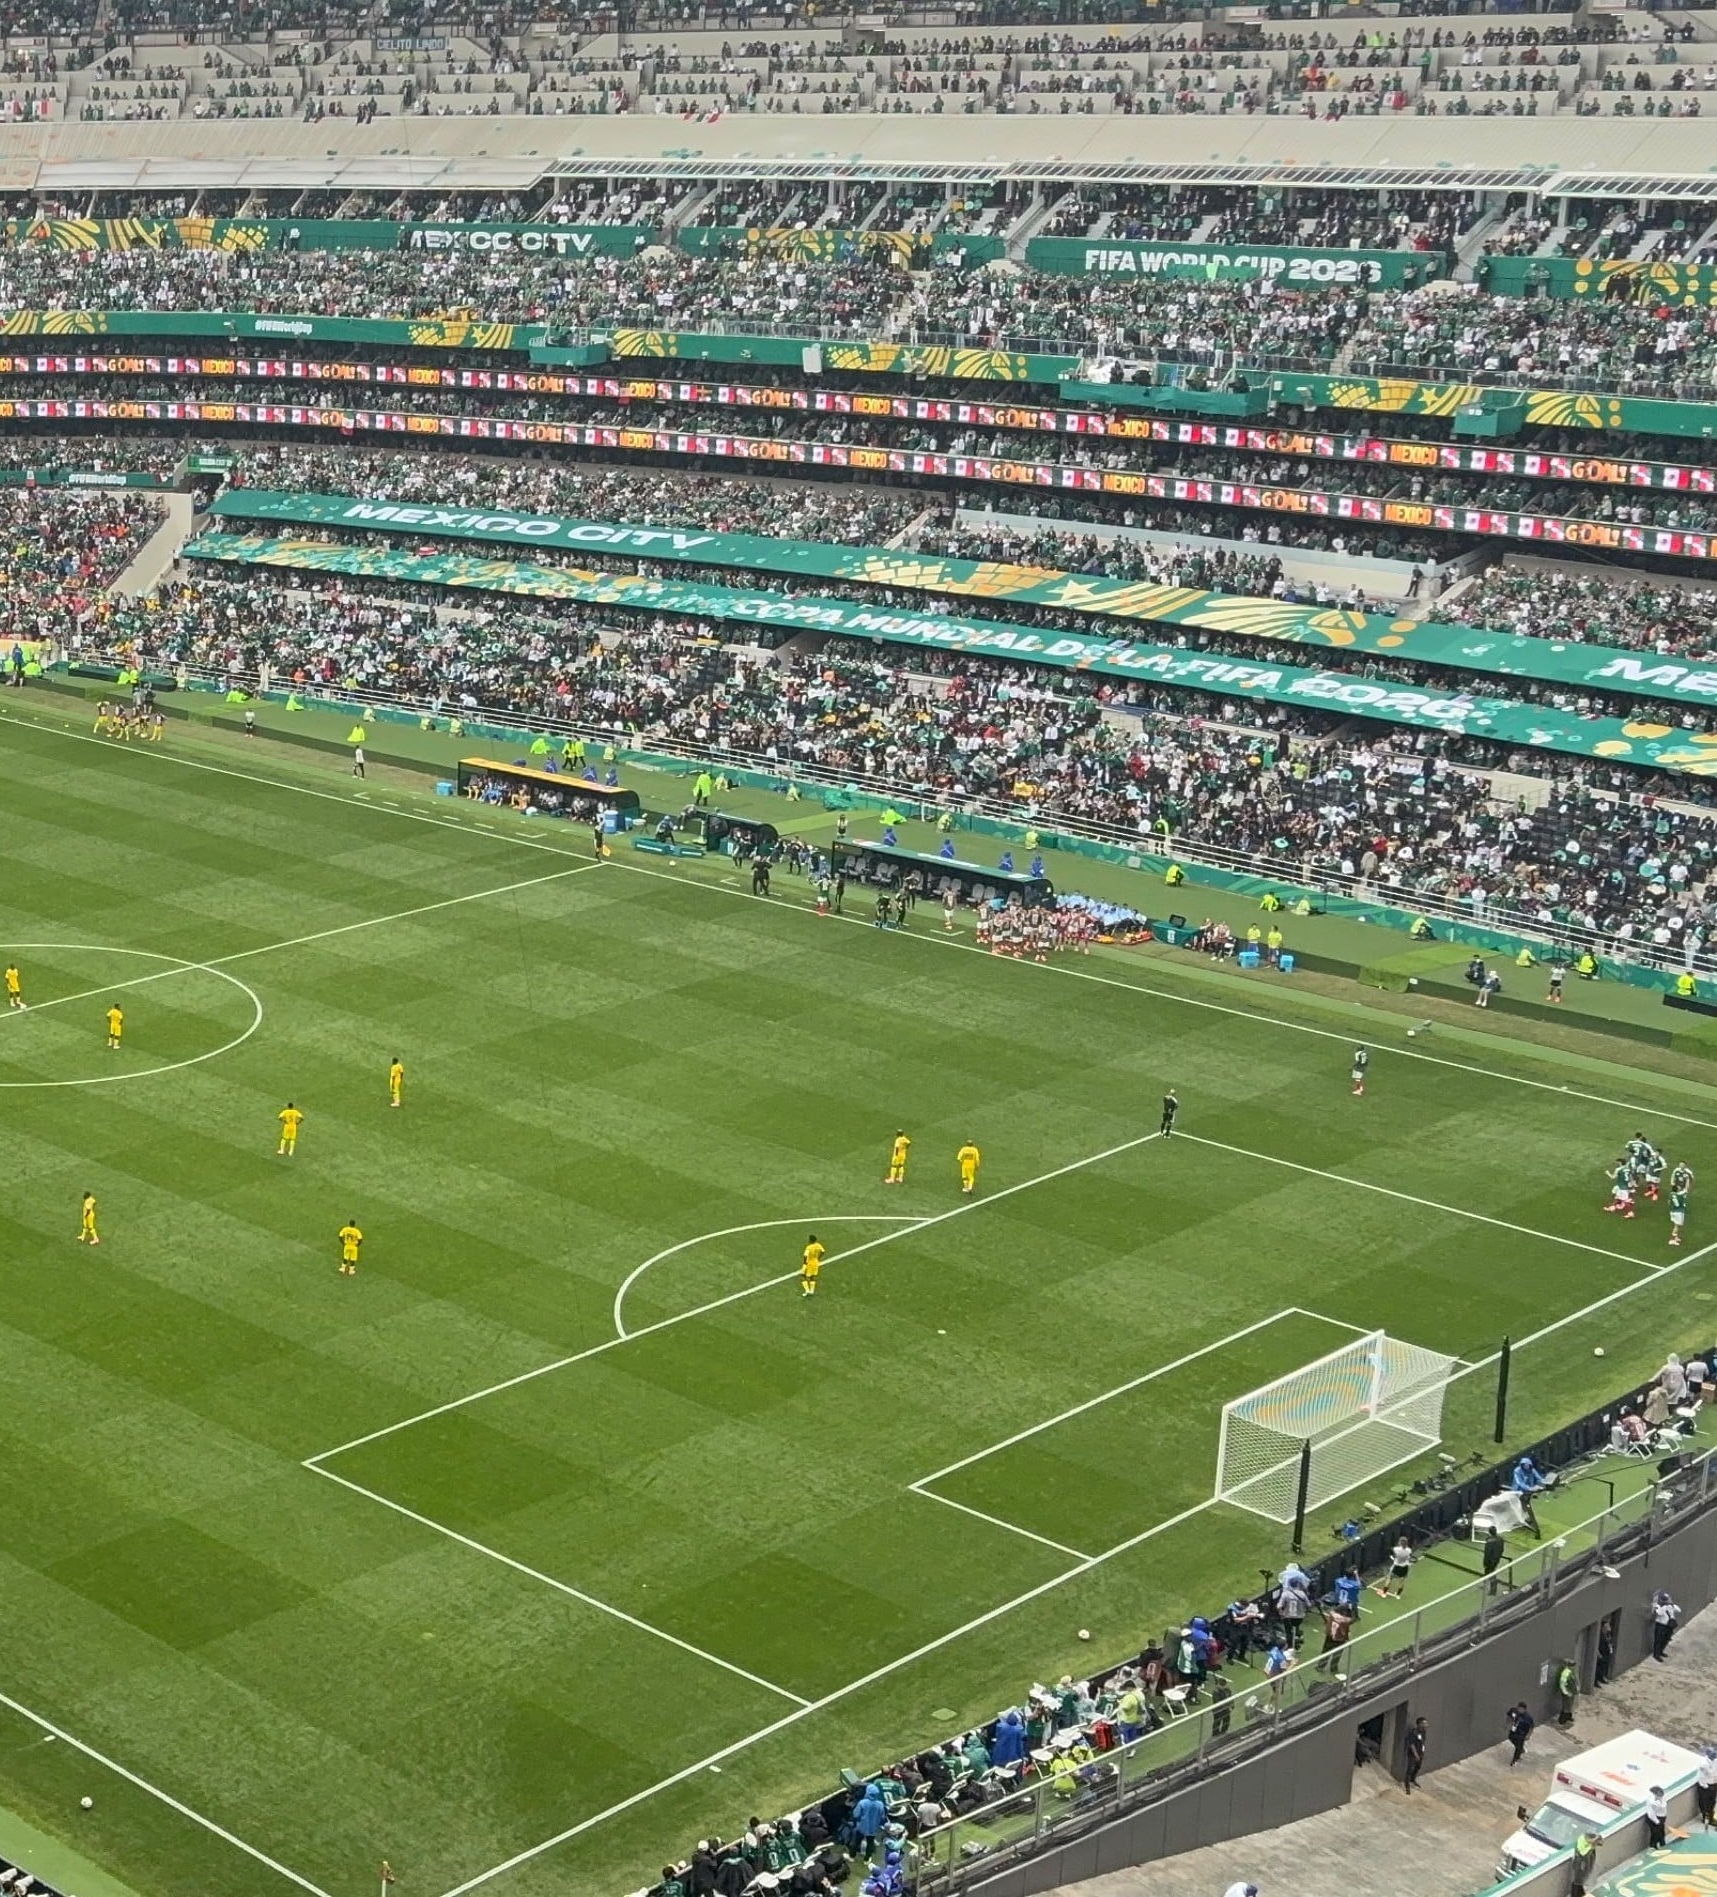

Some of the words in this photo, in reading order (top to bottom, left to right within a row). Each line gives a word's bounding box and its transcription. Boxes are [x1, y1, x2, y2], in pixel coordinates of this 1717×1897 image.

[1085, 250, 1136, 271] FIFA
[202, 359, 234, 373] MEXICO
[751, 390, 791, 407] GOAL!
[853, 397, 890, 414] MEXICO
[995, 411, 1038, 427] GOAL!
[620, 432, 654, 448] MEXICO
[749, 443, 788, 459] GOAL!
[850, 451, 887, 468] MEXICO
[1390, 443, 1437, 465] MEXICO
[991, 465, 1033, 482] GOAL!
[1572, 462, 1627, 483] GOAL!
[1103, 475, 1145, 493] MEXICO
[1261, 491, 1308, 511] GOAL!
[1385, 503, 1432, 525] MEXICO
[343, 503, 561, 536] MEXICO
[568, 525, 715, 549] CITY
[1565, 524, 1620, 546] GOAL!
[733, 599, 843, 625] COPA
[843, 613, 1040, 652] MUNDIAL
[1179, 659, 1283, 688] FIFA
